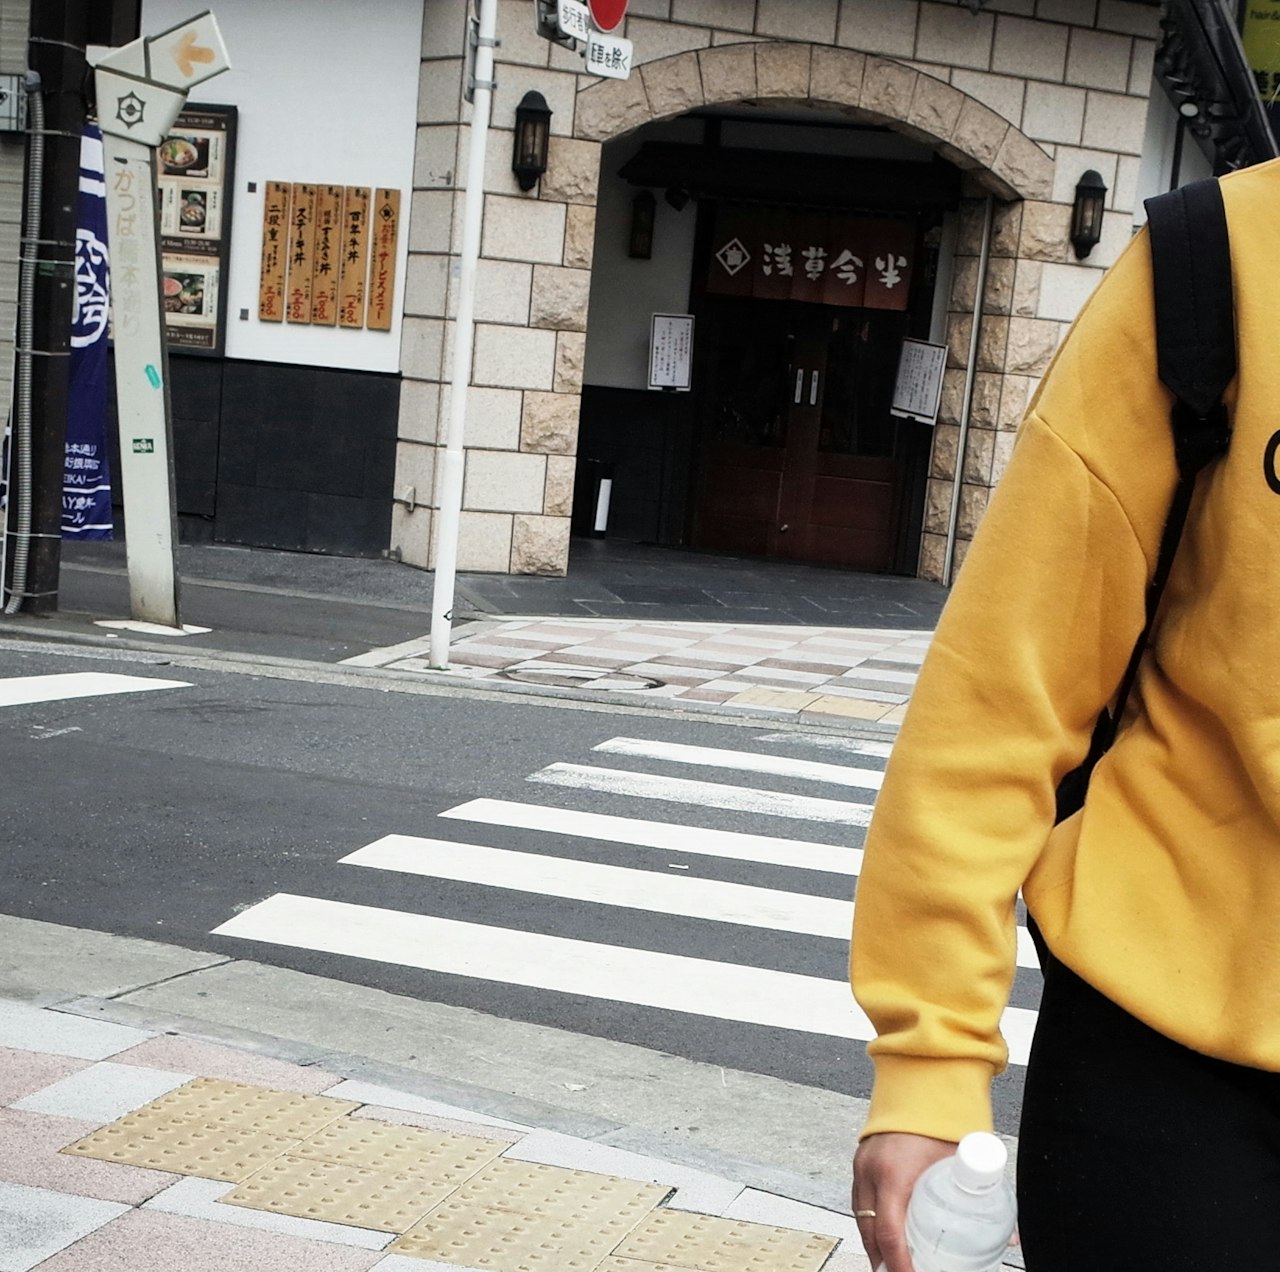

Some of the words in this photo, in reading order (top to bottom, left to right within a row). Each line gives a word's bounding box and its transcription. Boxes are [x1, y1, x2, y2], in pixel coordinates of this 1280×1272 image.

[562, 5, 590, 35] 歩行者
[762, 242, 908, 289] 浅草今半
